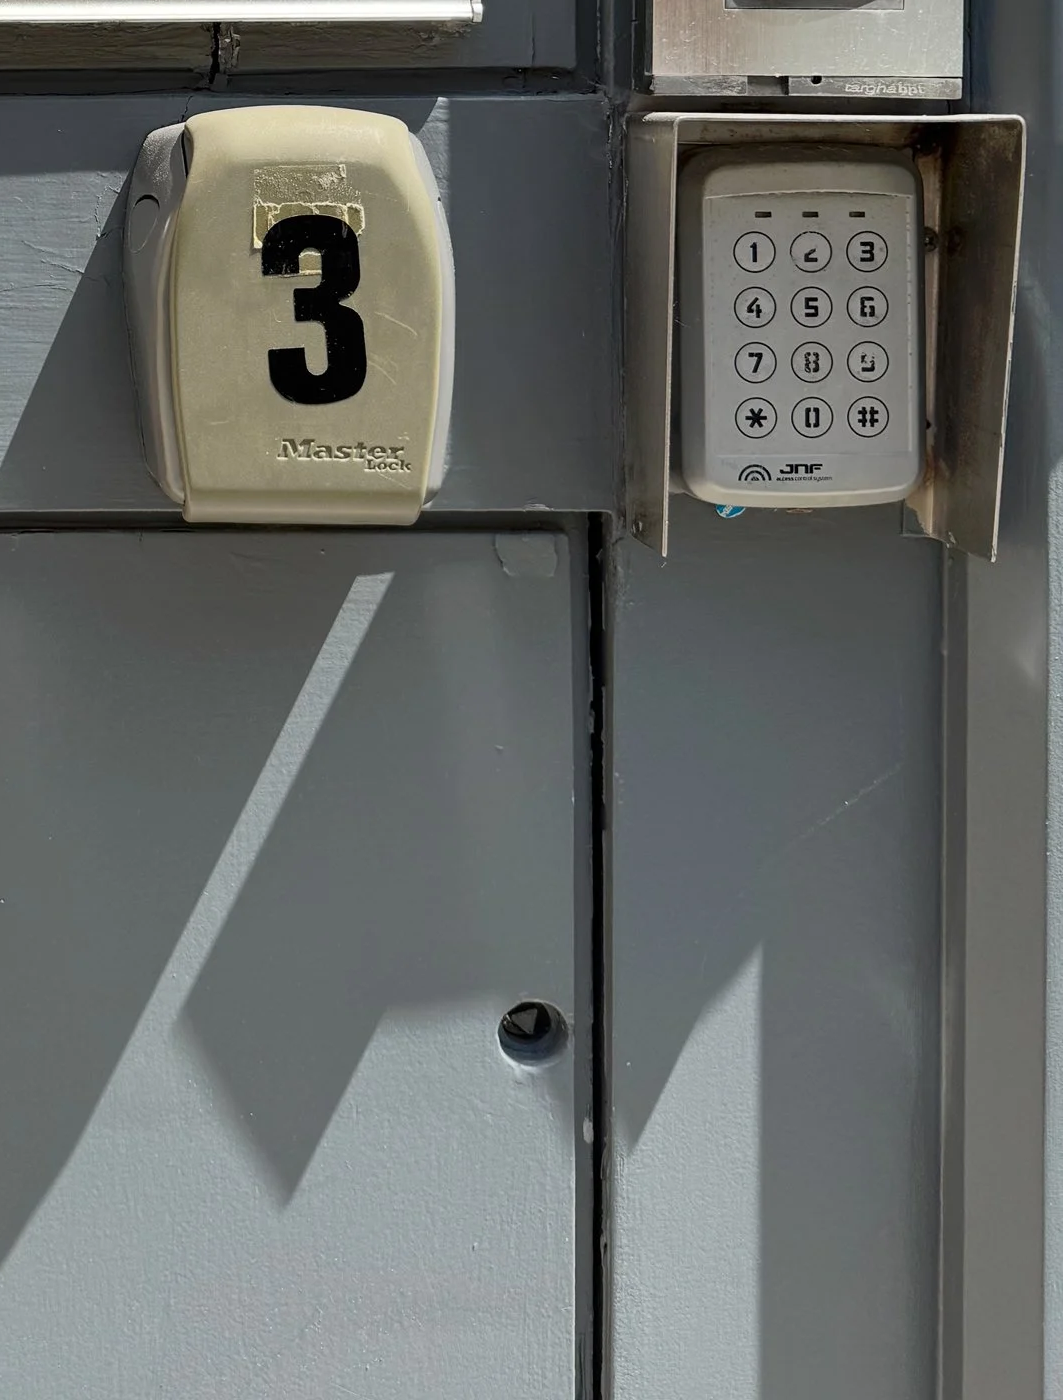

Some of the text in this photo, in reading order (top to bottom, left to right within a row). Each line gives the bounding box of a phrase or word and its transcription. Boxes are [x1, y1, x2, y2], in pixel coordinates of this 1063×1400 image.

[749, 241, 758, 263] 1
[860, 241, 875, 263] 3
[261, 214, 367, 405] 3
[746, 296, 875, 318] 4 5 6
[747, 352, 763, 373] 7
[276, 438, 404, 462] Master
[363, 458, 411, 472] Lock
[779, 463, 823, 475] JNF
